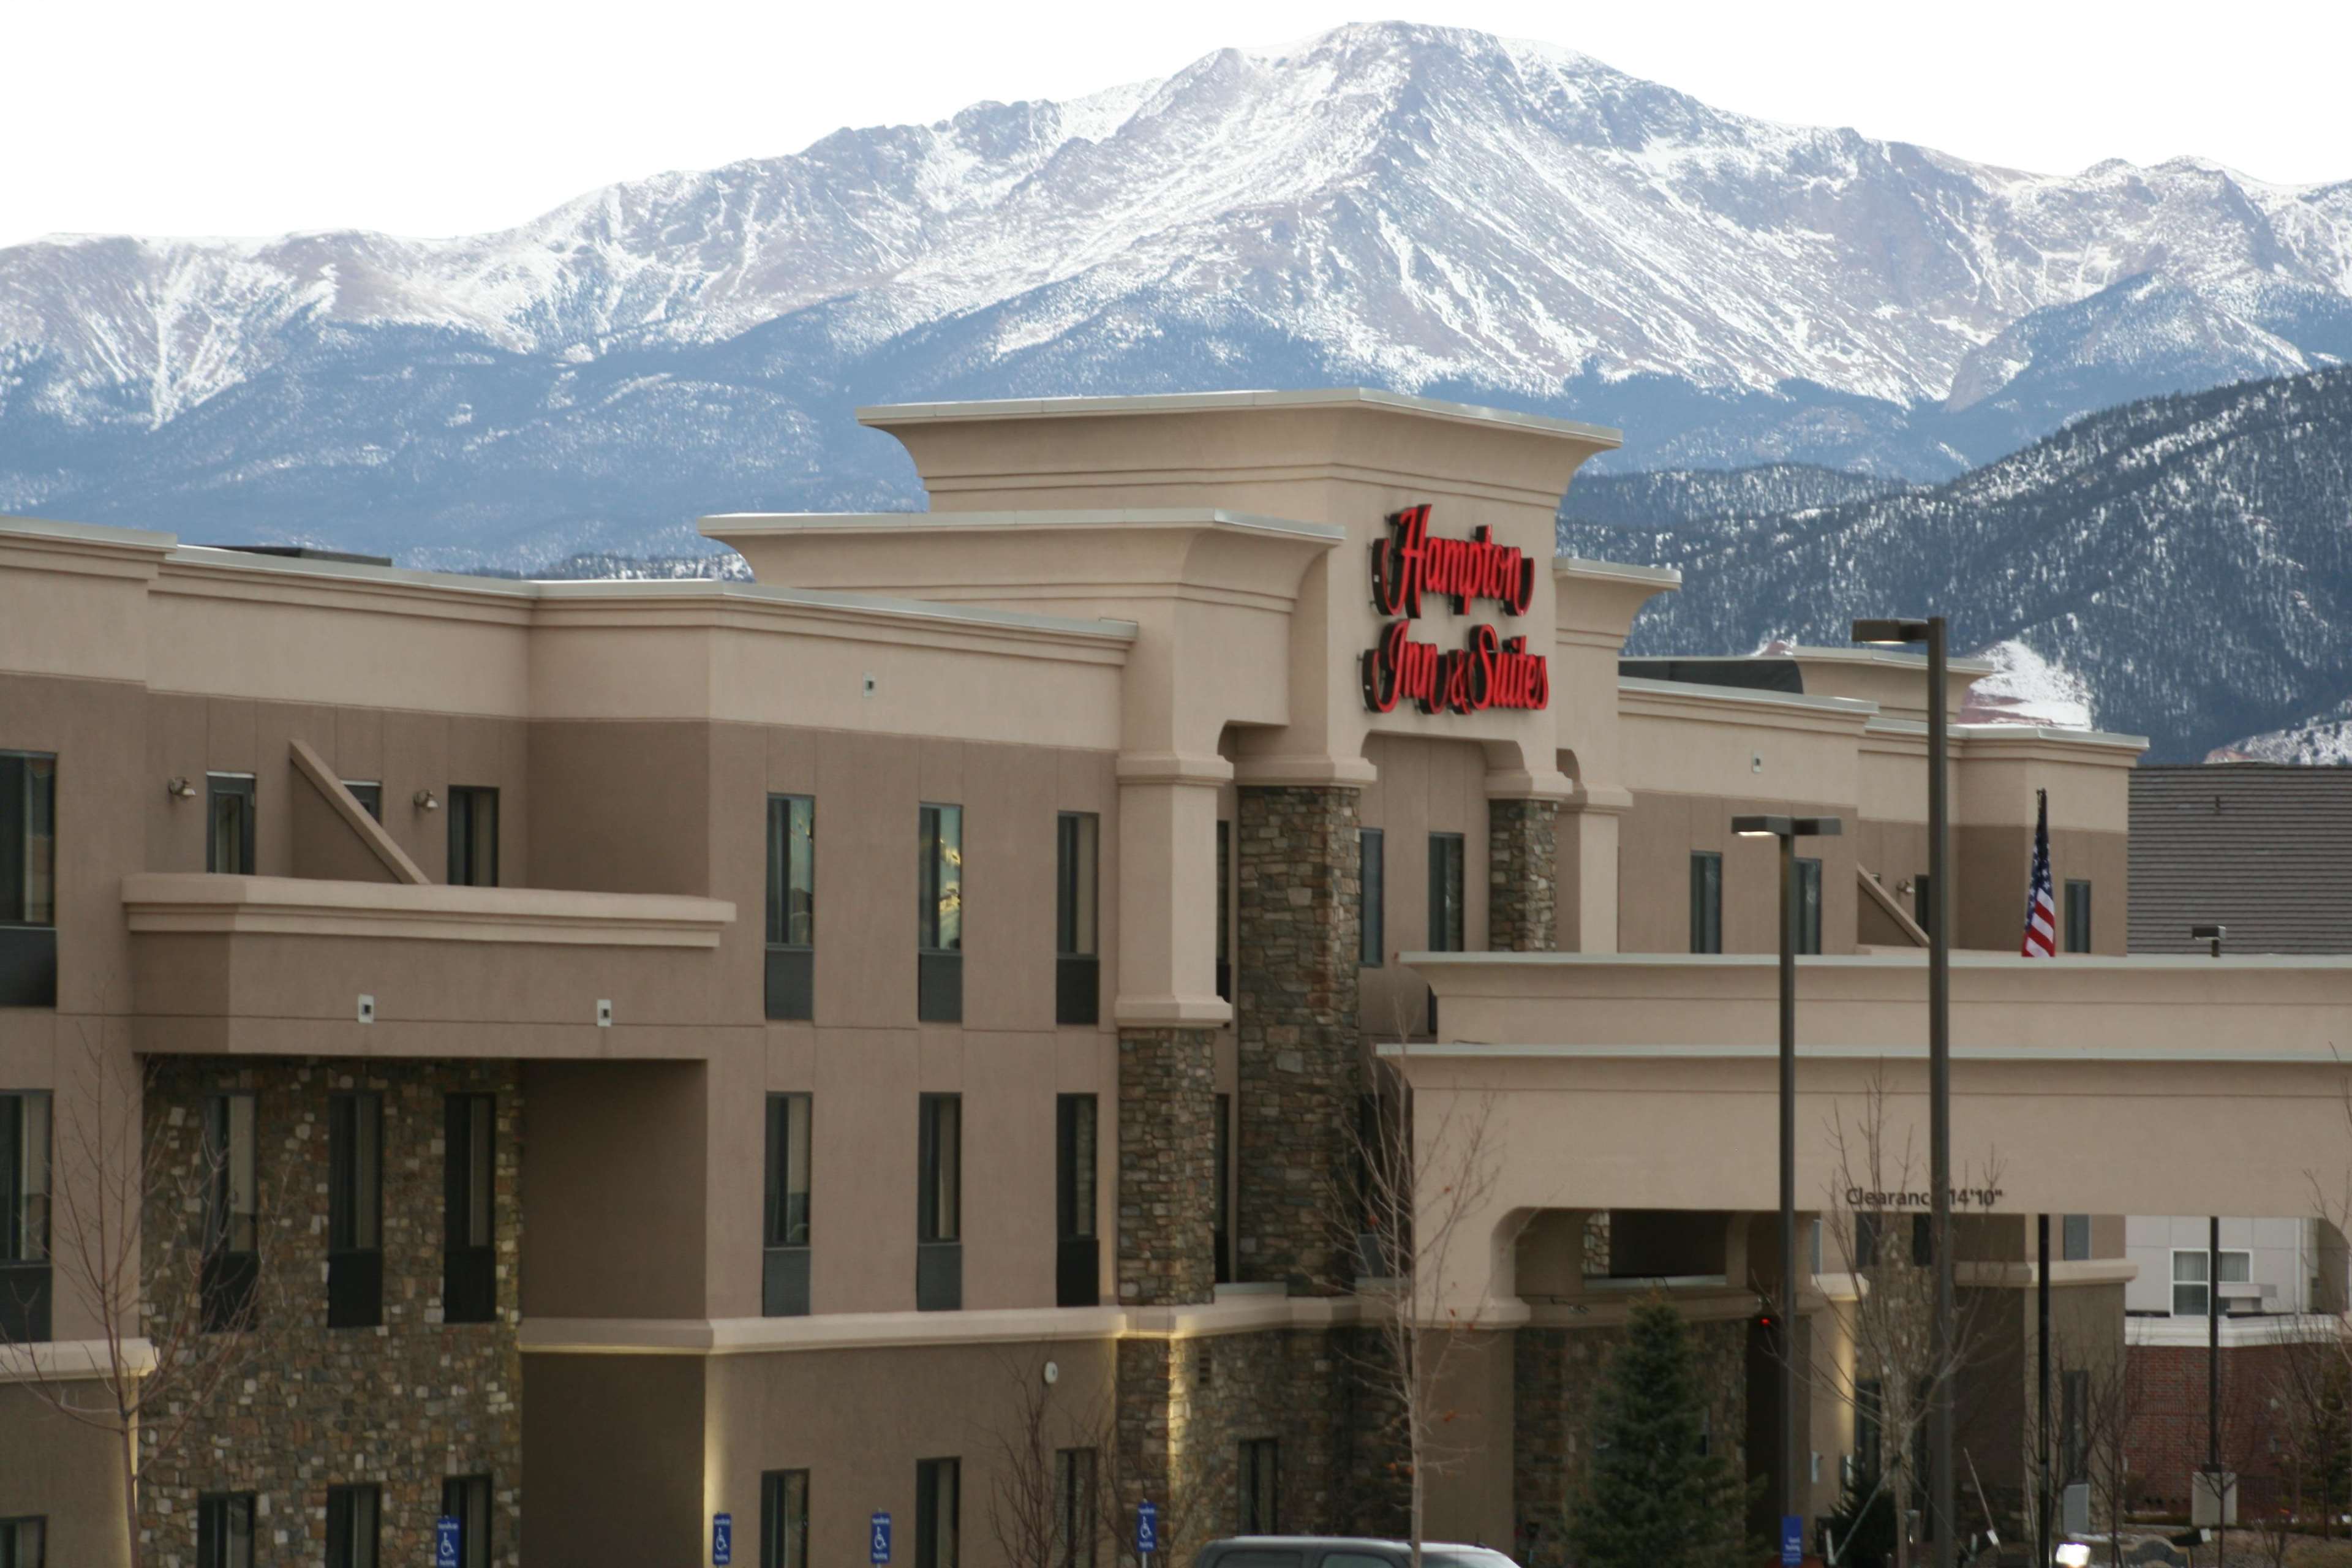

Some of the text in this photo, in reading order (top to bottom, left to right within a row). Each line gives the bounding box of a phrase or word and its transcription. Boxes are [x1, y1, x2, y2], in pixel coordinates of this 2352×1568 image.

[1372, 504, 1534, 619] Hampton
[1362, 619, 1548, 715] Inn & Suites
[1845, 1187, 1932, 1206] Clearanc
